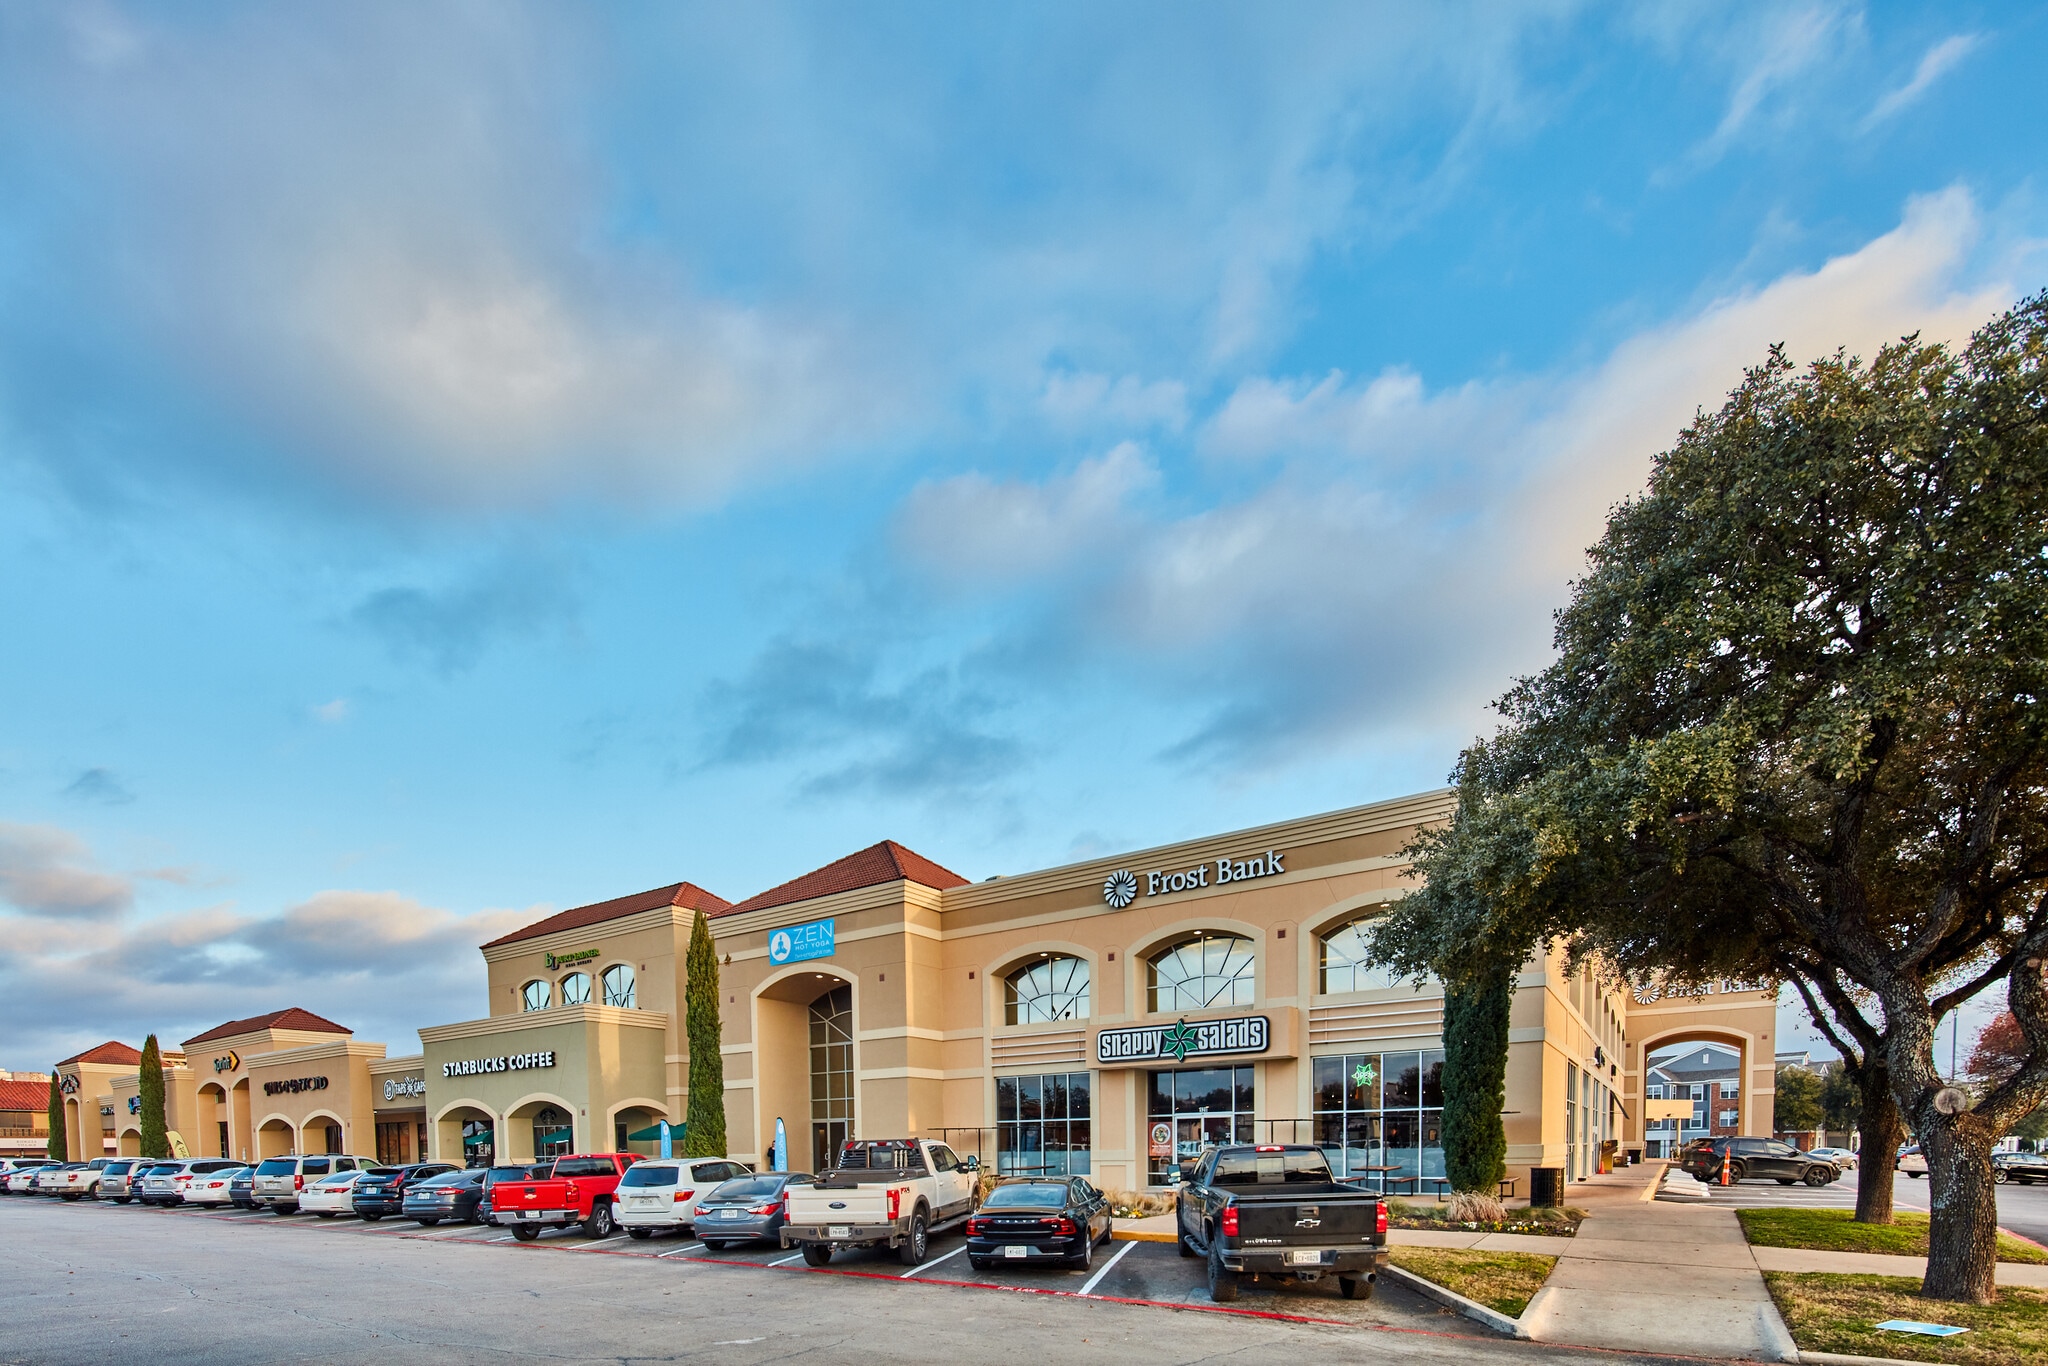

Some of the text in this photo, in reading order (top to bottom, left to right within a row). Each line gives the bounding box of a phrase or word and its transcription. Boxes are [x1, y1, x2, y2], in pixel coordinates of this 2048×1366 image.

[1147, 850, 1286, 897] Frost Bank
[793, 922, 833, 944] ZEN
[795, 939, 830, 951] HOT YOGA
[1101, 1018, 1261, 1058] snappy salads
[443, 1051, 555, 1077] STARBUCKS COFFEE
